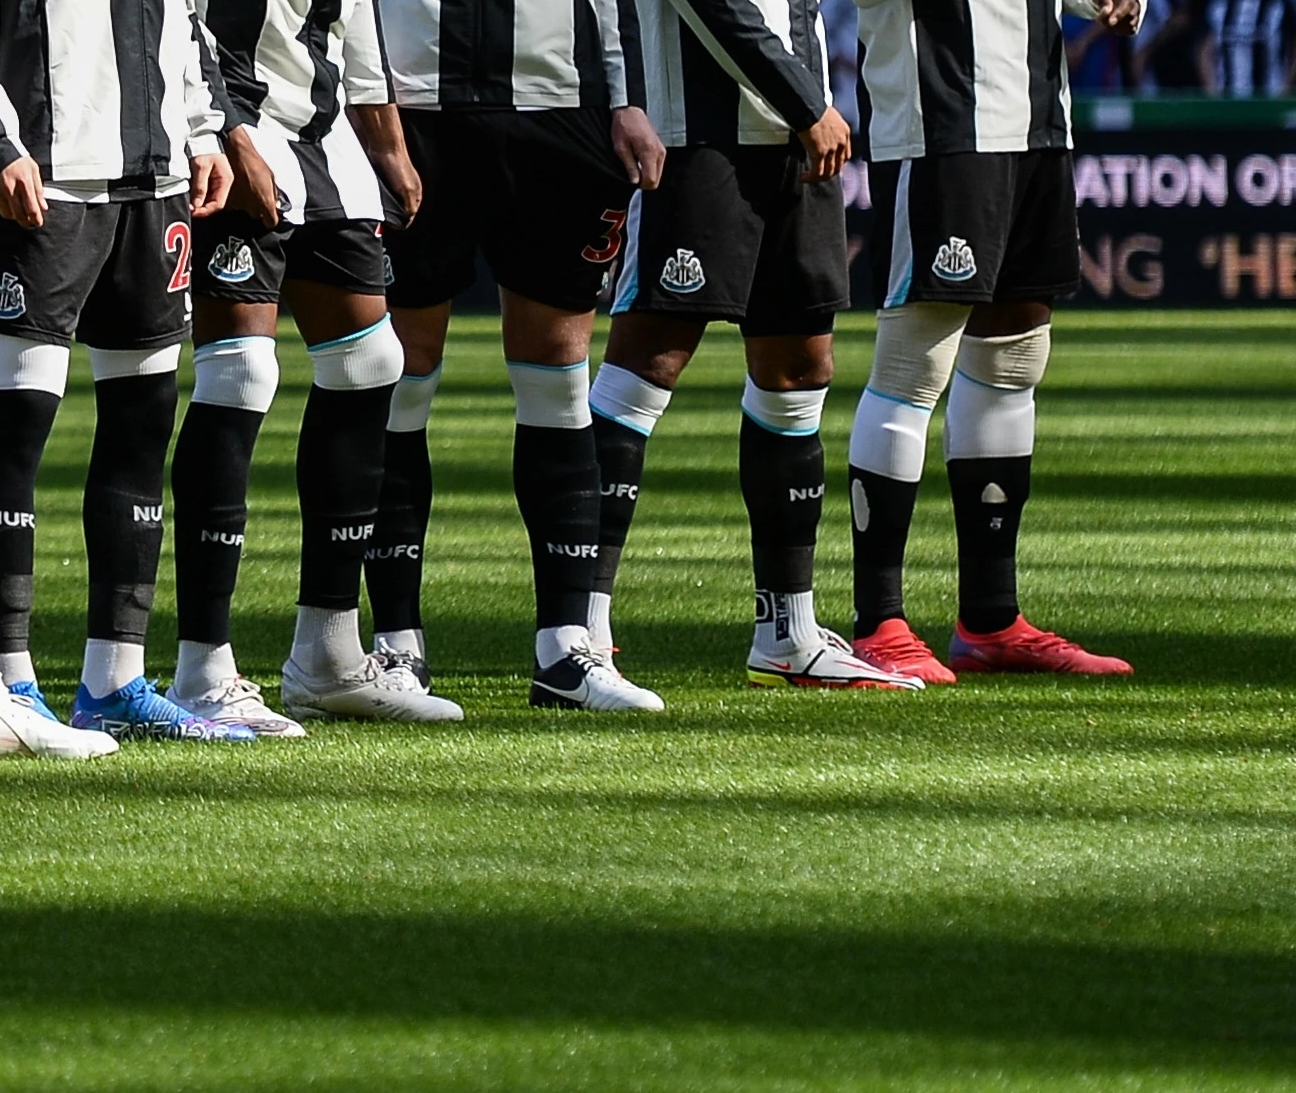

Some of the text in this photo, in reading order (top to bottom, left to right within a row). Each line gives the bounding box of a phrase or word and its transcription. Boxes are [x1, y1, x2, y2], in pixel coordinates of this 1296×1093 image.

[581, 208, 627, 263] 3
[600, 483, 638, 501] UFC
[547, 541, 599, 559] NUFC
